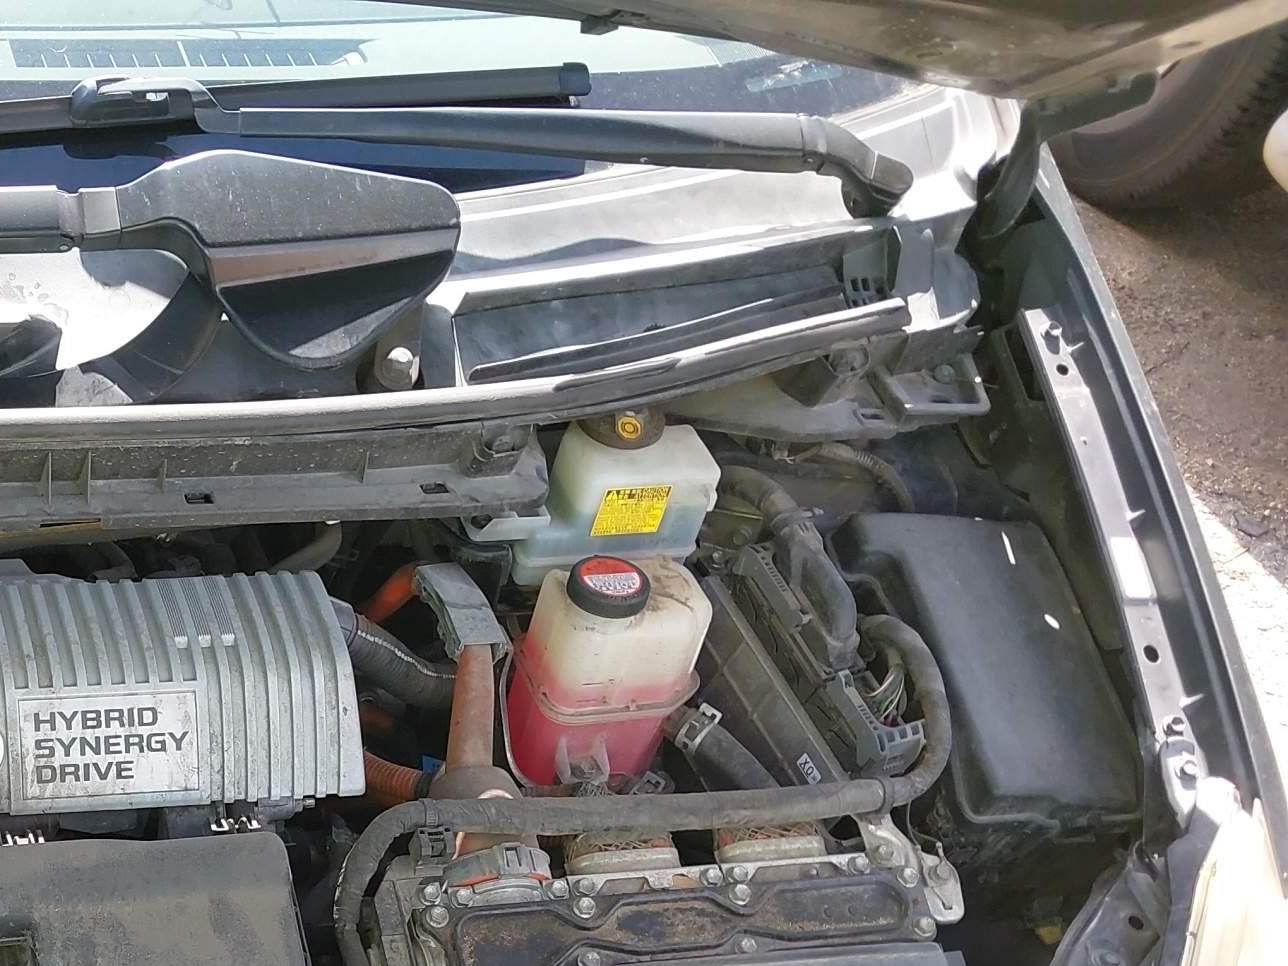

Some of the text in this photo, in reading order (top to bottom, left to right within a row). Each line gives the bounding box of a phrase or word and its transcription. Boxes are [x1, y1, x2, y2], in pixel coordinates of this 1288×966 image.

[33, 706, 159, 732] HYBRID
[34, 730, 190, 759] SYNERGY
[35, 760, 135, 785] DRIVE
